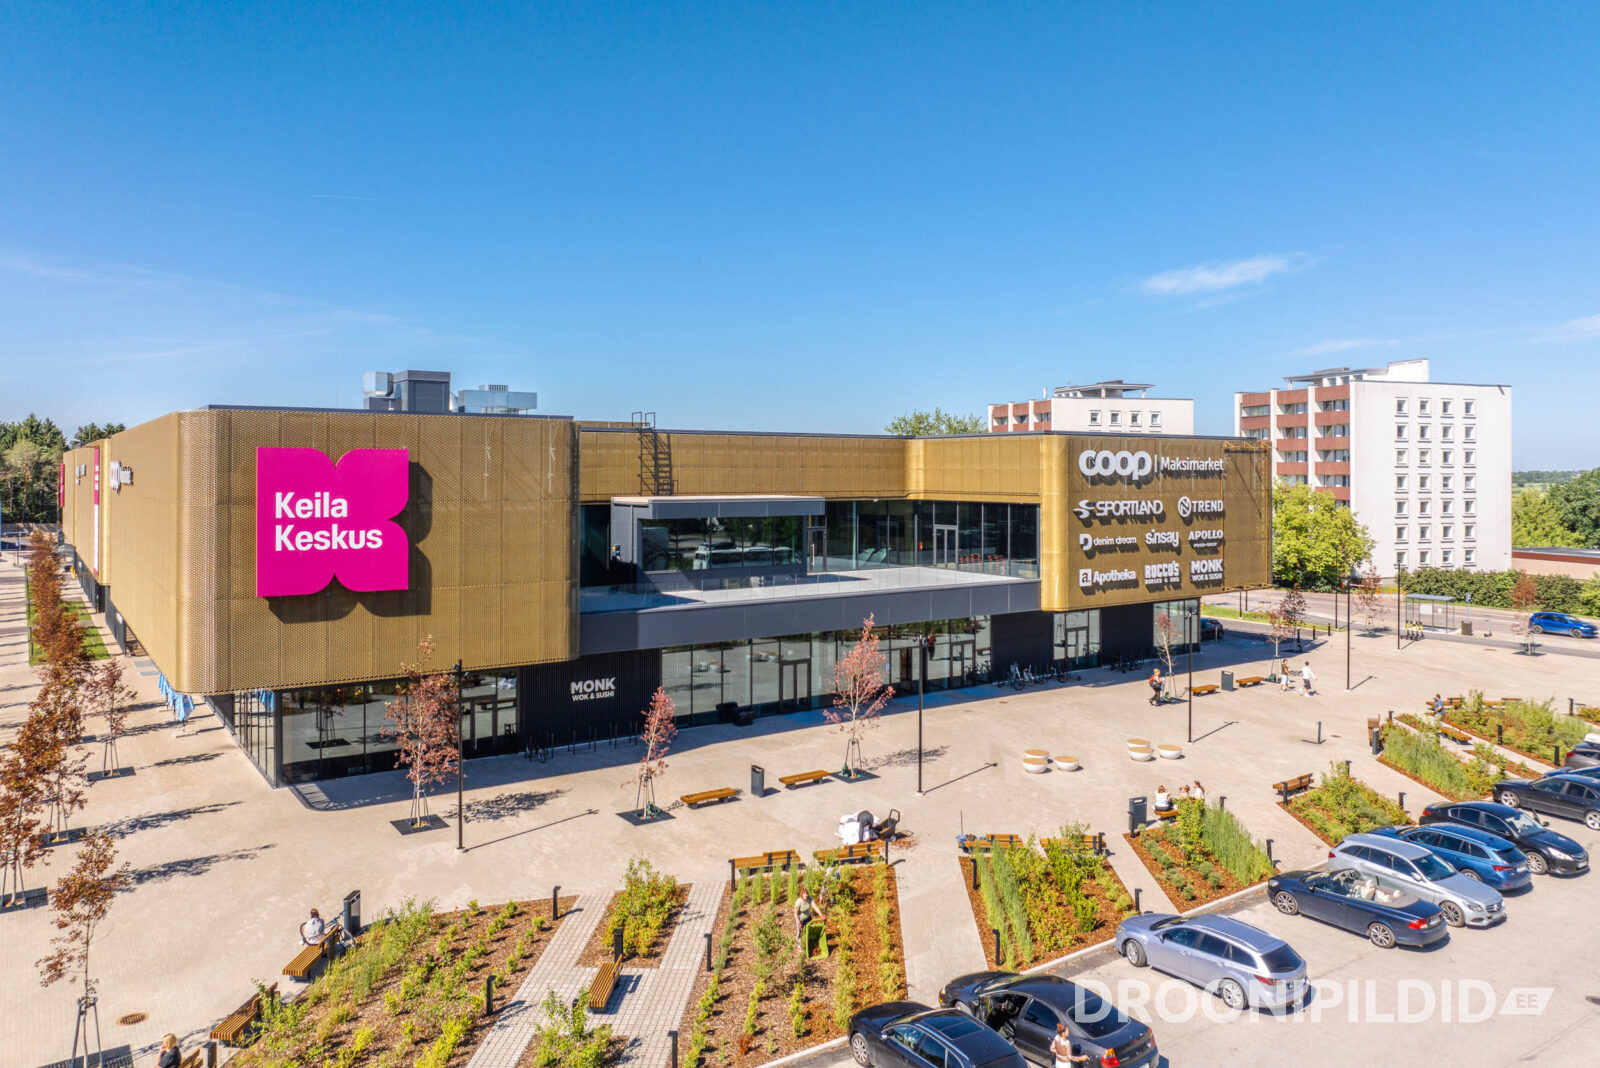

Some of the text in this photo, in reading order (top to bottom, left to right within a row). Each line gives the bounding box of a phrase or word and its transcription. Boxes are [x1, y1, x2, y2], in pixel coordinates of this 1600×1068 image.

[1160, 456, 1224, 471] Maksimarket
[275, 491, 348, 519] Keila
[1096, 500, 1163, 516] SPORTLAND
[1191, 500, 1223, 513] TREND
[275, 523, 383, 552] Keskus
[1093, 535, 1137, 546] denim dream
[1145, 529, 1179, 547] sinsay
[1188, 530, 1223, 540] APOLLO
[1145, 560, 1179, 578] ROCCO'S
[1190, 559, 1223, 574] MONK
[1092, 568, 1137, 585] Apotheka
[571, 677, 616, 694] MONK
[596, 690, 615, 698] SUSHI
